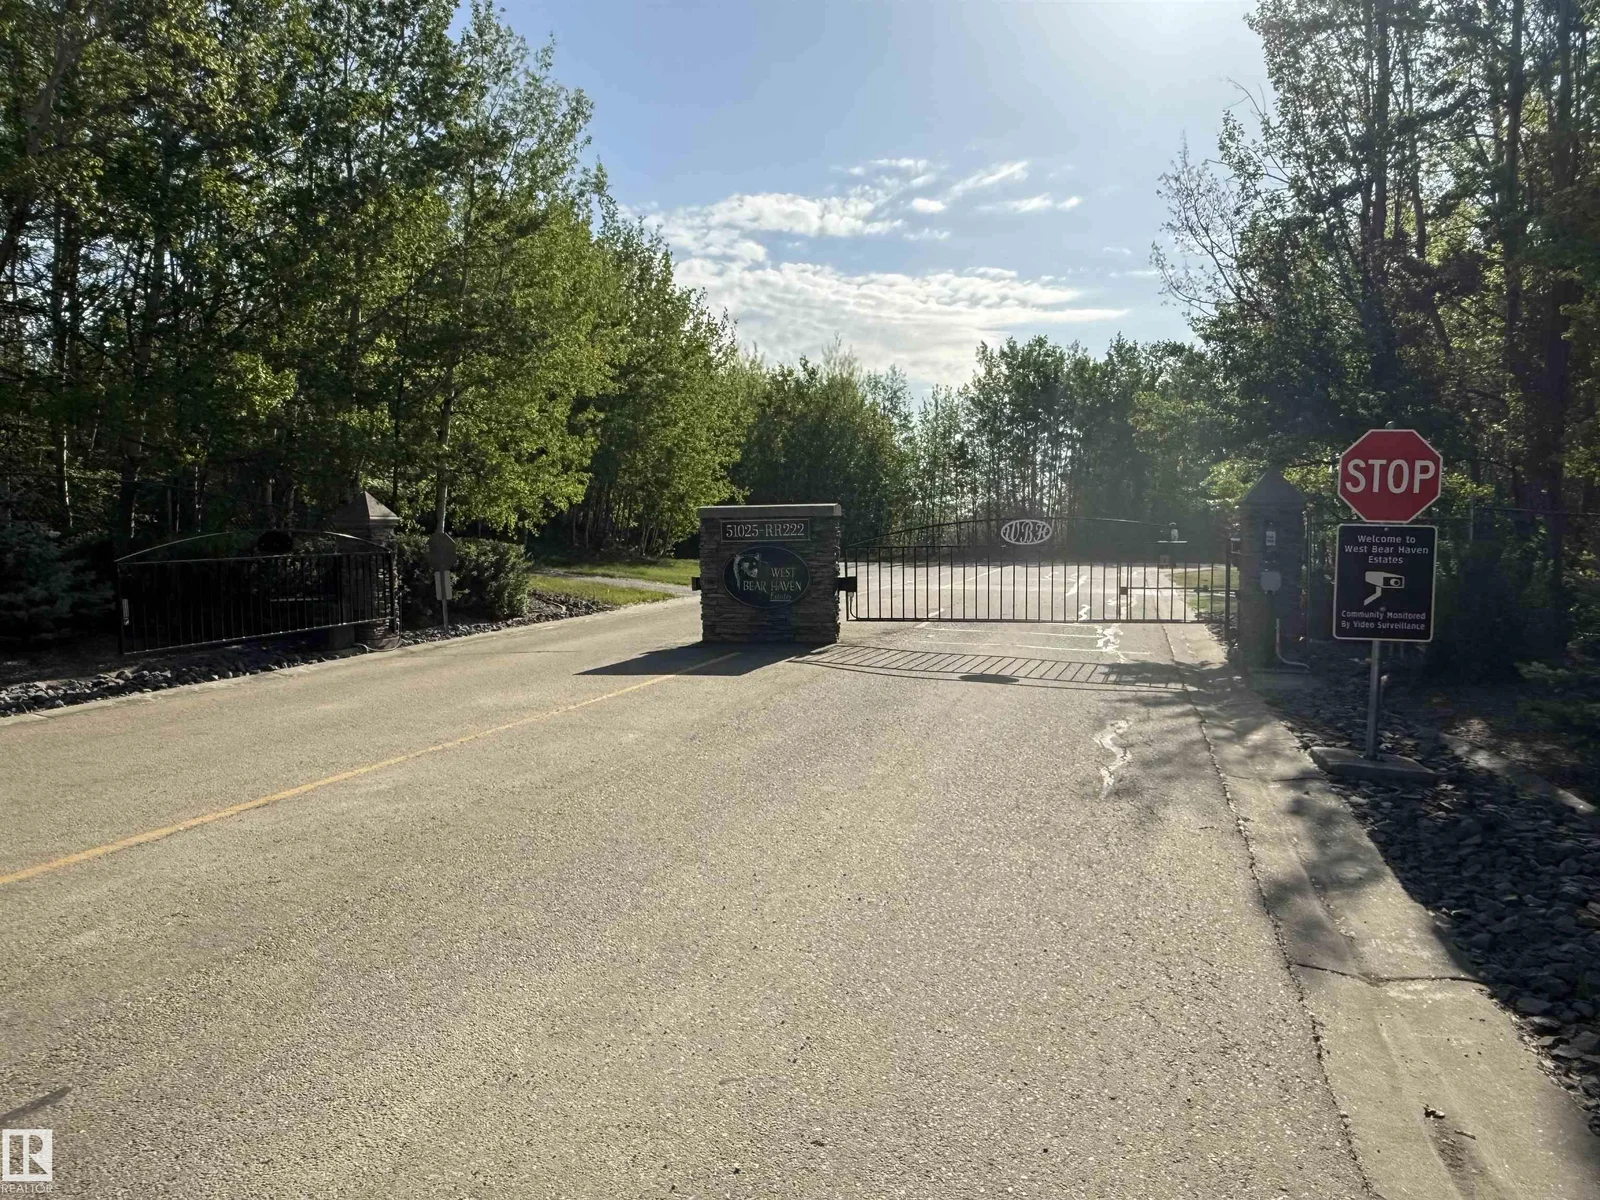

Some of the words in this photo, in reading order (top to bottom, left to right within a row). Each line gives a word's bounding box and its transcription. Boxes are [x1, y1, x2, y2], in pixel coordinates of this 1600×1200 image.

[1346, 459, 1435, 494] STOP
[1357, 535, 1402, 543] Welcome
[1345, 545, 1368, 553] West
[1399, 546, 1429, 554] Haven
[1367, 556, 1404, 564] Estates
[771, 568, 796, 577] WEST
[743, 581, 766, 592] BEAR
[771, 581, 802, 591] HAVEN
[1342, 610, 1384, 620] Community
[1386, 611, 1426, 619] Monitored
[1341, 621, 1350, 629] By
[1377, 622, 1425, 630] Surveillance
